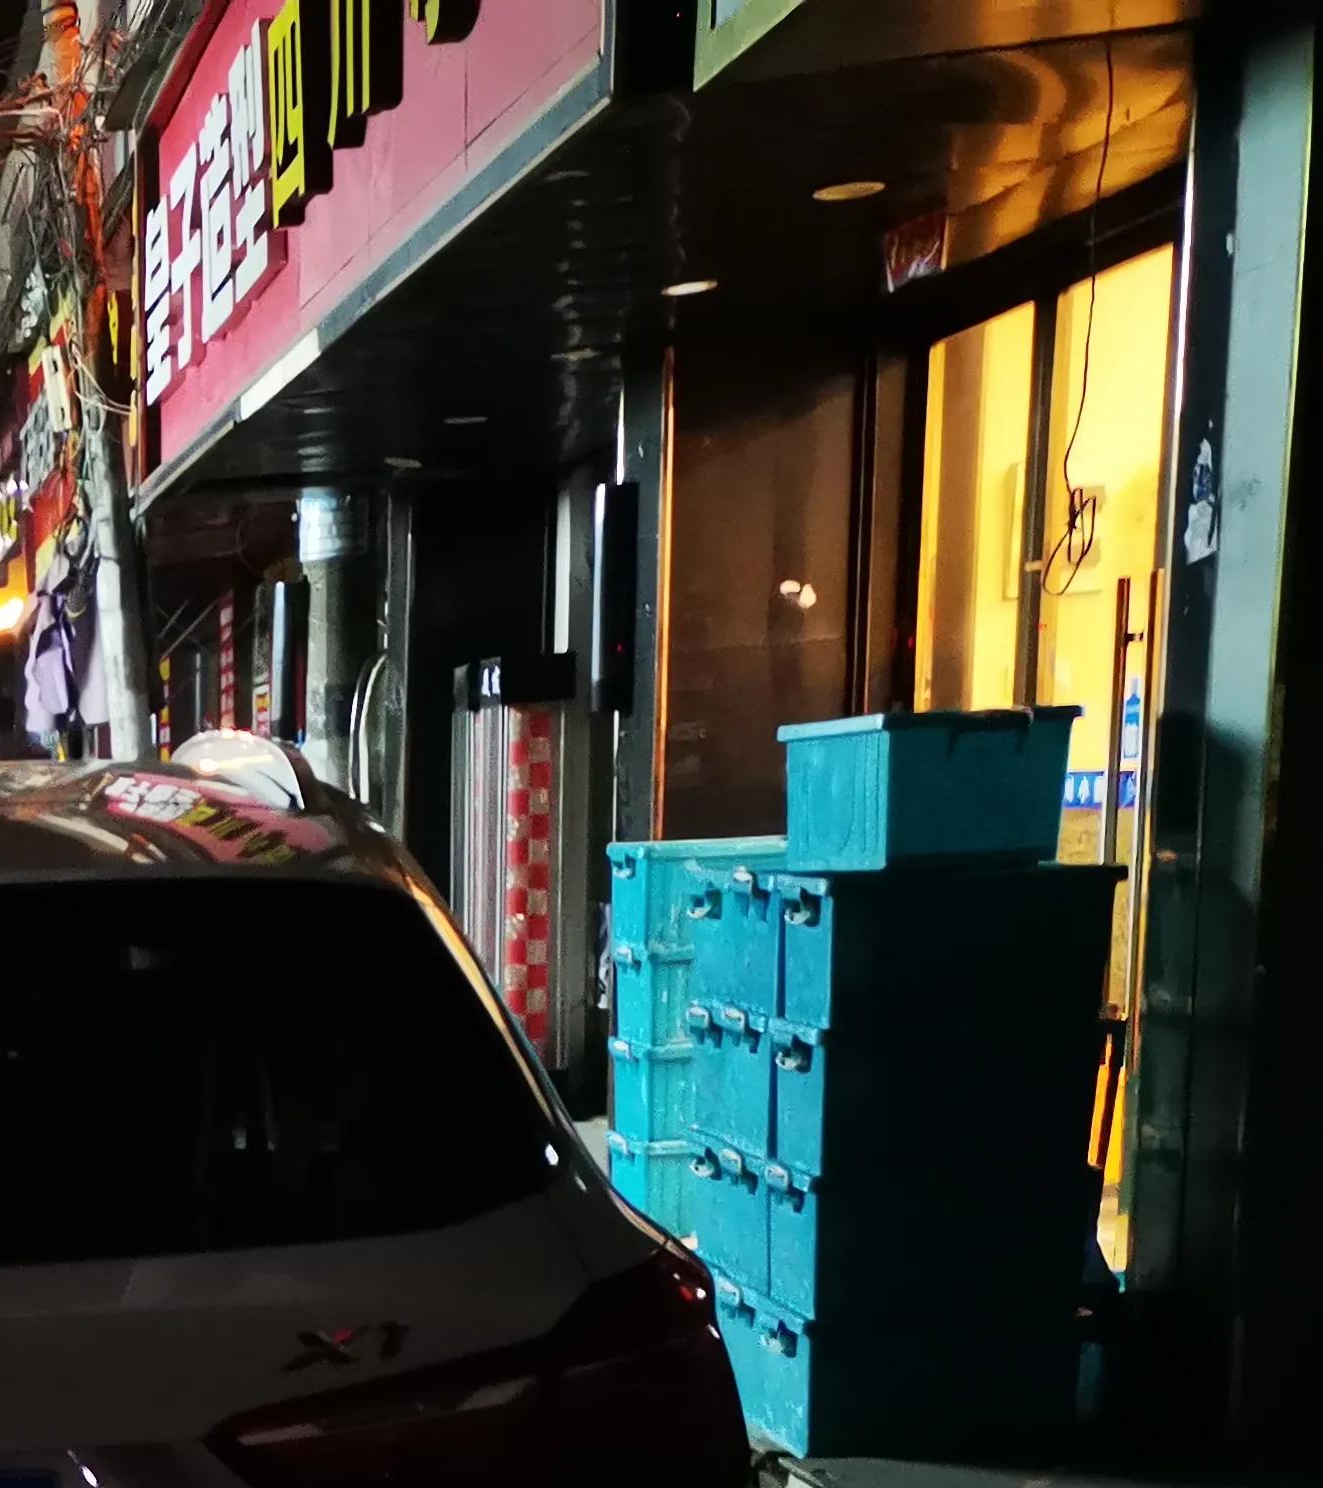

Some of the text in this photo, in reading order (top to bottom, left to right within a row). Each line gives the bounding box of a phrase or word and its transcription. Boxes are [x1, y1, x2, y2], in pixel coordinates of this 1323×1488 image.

[145, 17, 269, 406] 皇子造型
[280, 1319, 410, 1372] X1
